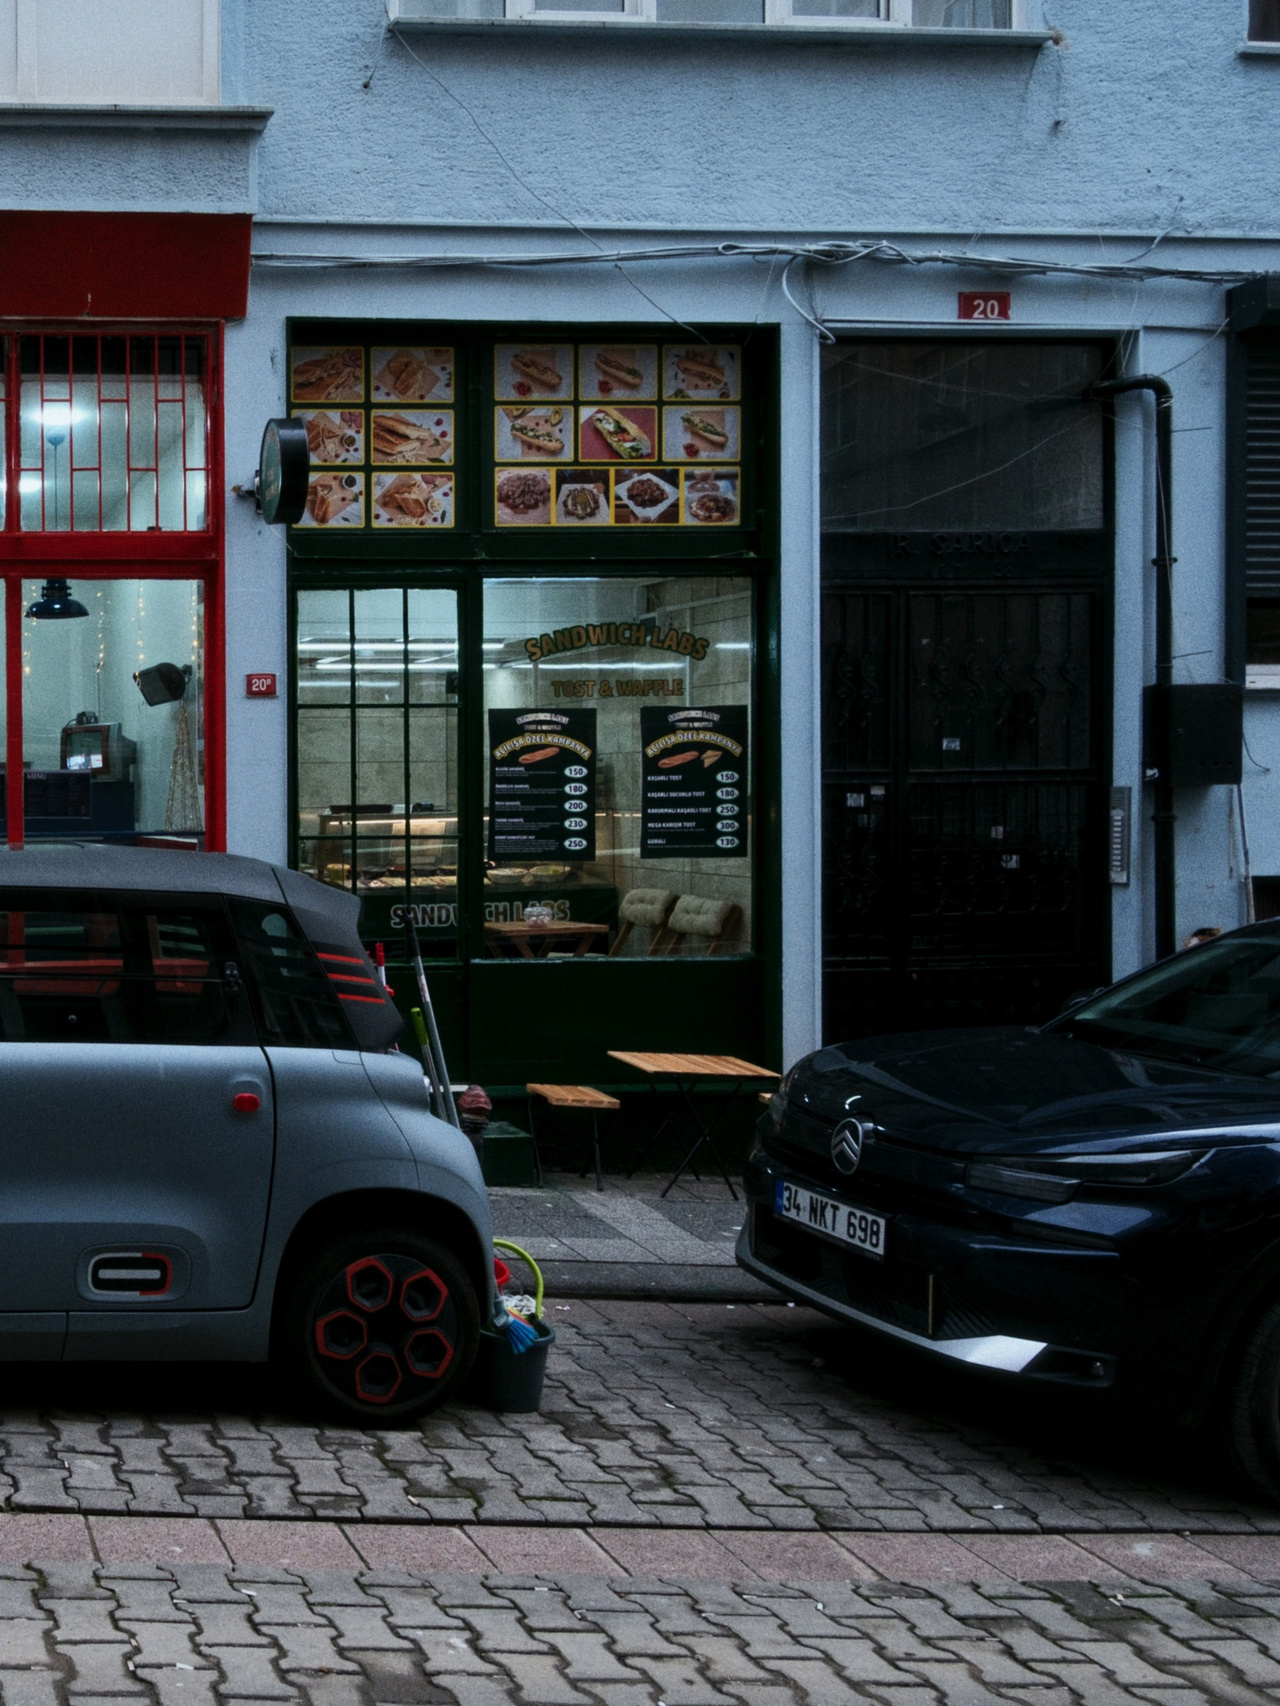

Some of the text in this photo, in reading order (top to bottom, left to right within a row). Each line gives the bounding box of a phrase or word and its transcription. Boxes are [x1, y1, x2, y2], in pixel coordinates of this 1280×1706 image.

[972, 300, 999, 319] 20
[524, 622, 710, 662] SANDWICH LABS
[551, 678, 684, 698] TOST & WAFFLE
[547, 735, 591, 758] KAMPANYA
[699, 732, 741, 755] KAMPANYA
[783, 1185, 881, 1249] 34 NKT 698
